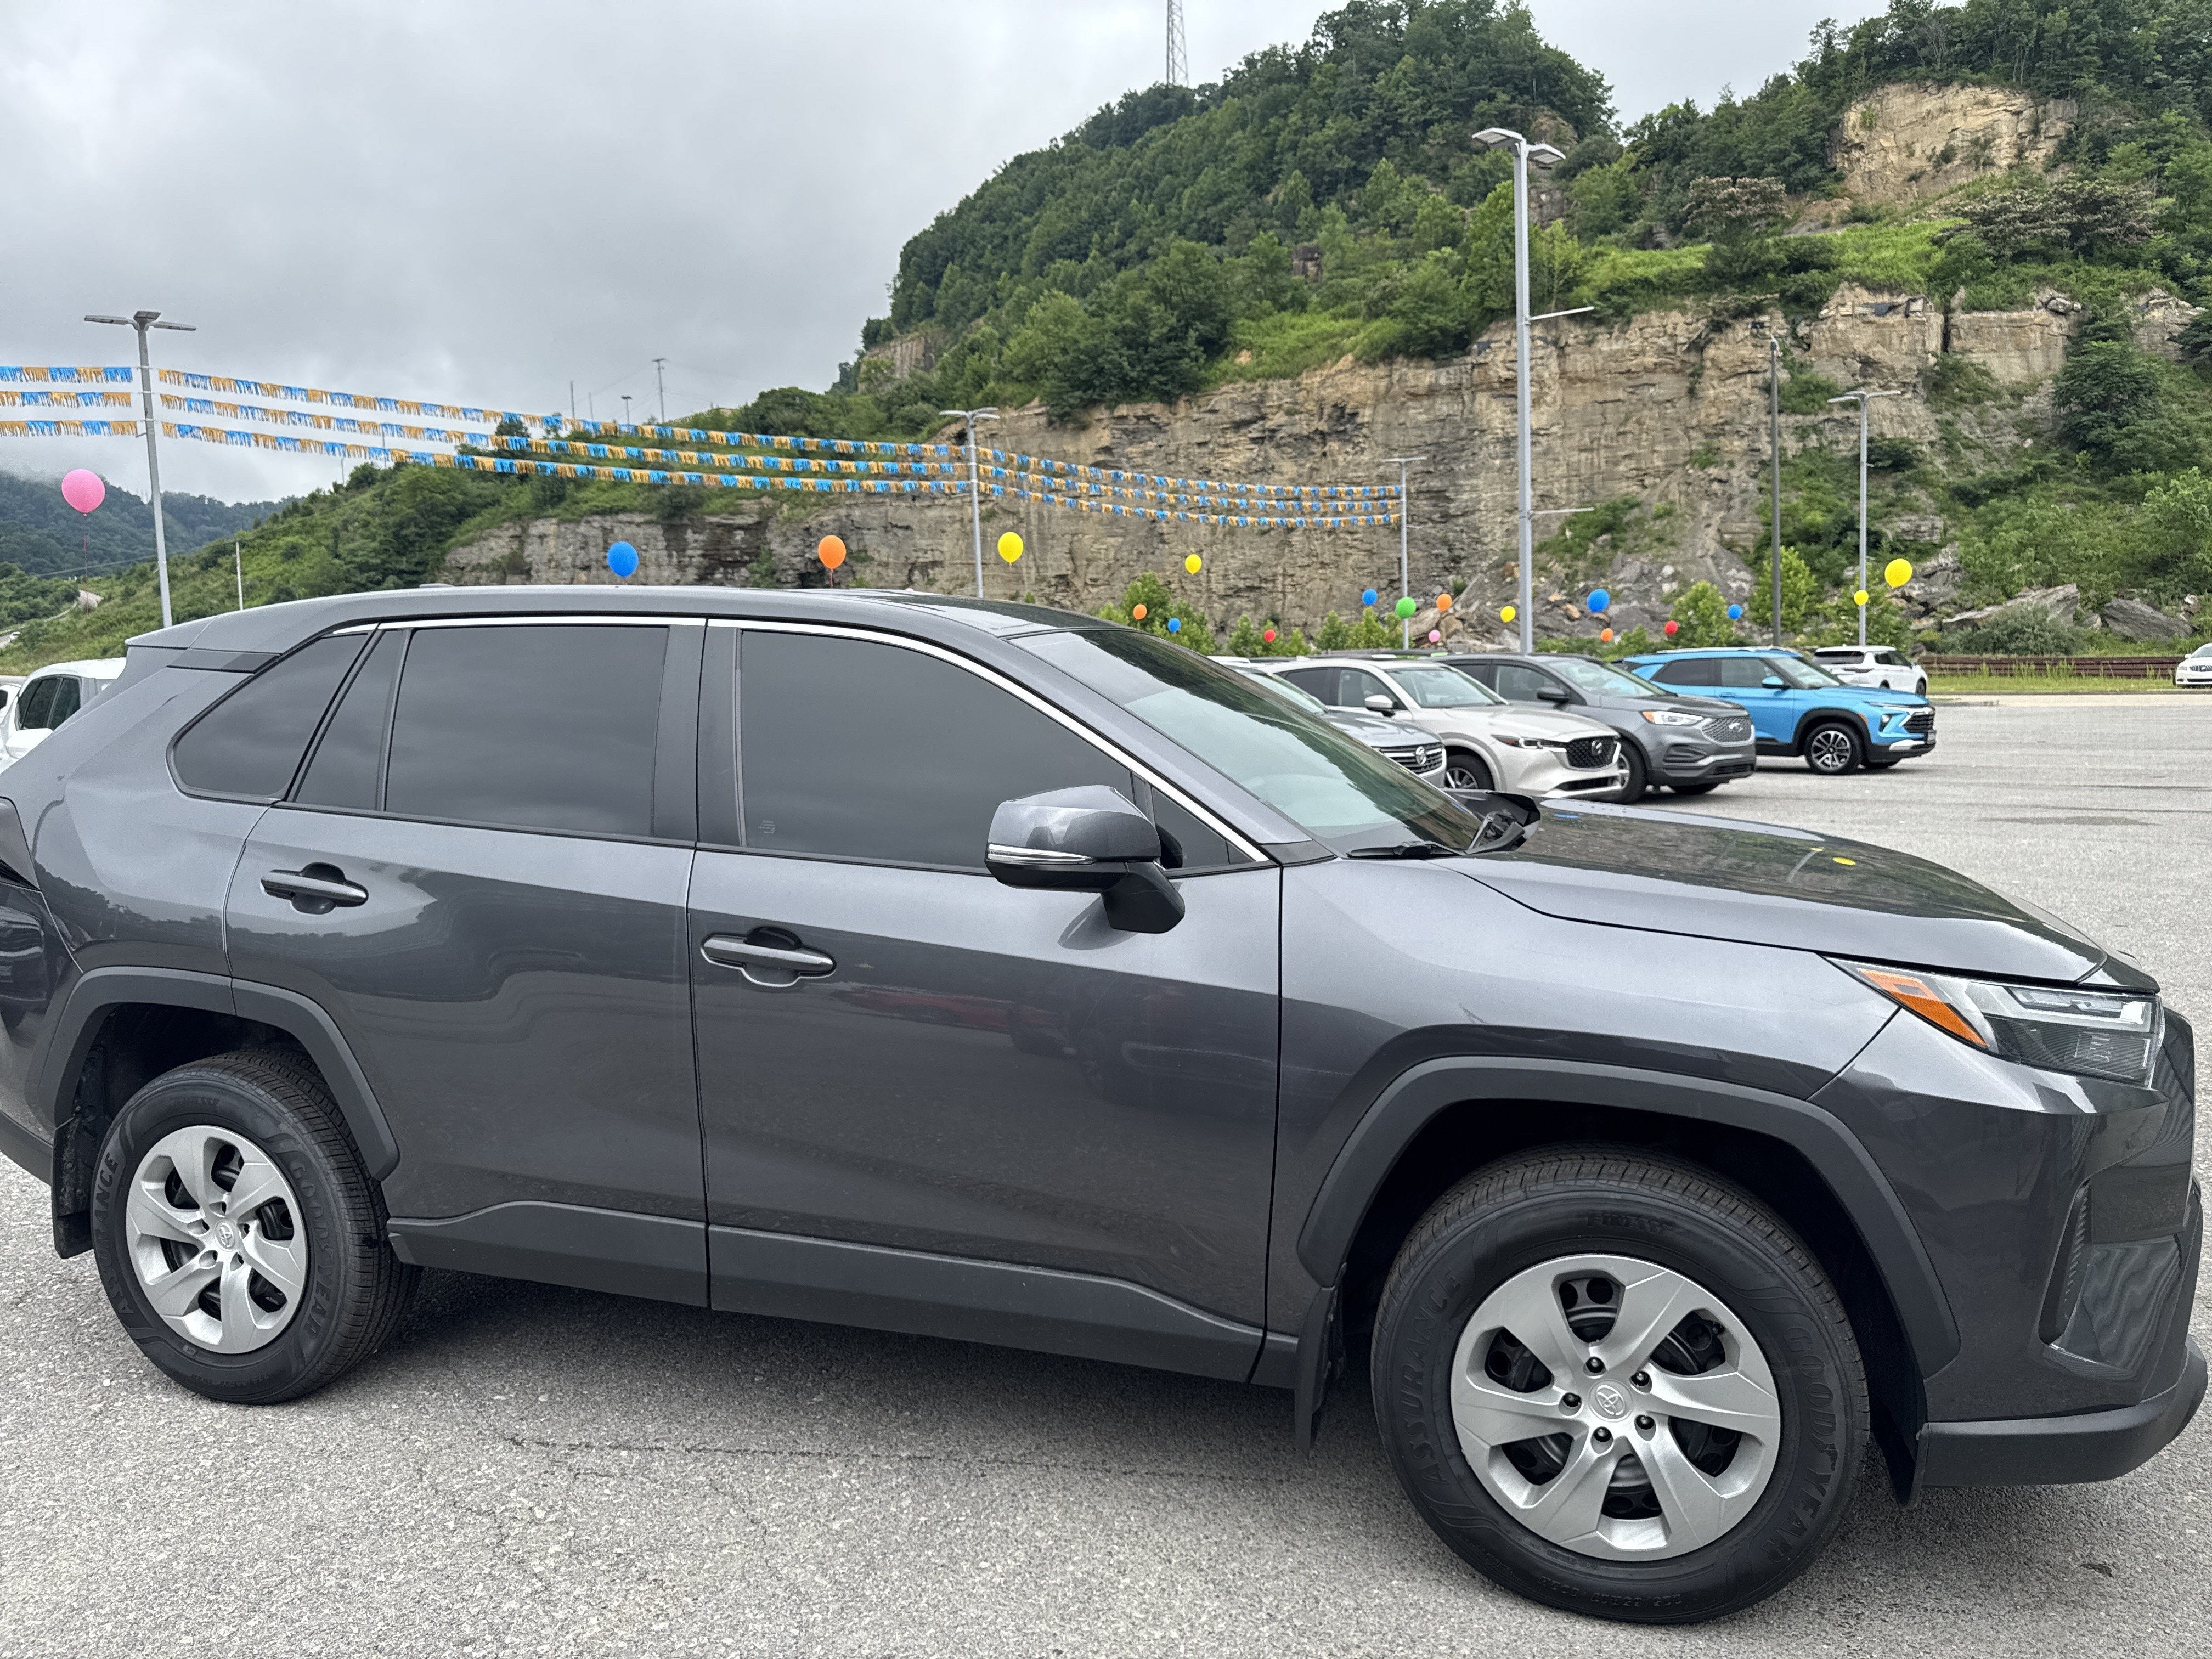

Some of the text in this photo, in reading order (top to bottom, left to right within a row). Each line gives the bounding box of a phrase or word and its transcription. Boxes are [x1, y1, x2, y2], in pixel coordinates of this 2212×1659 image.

[94, 1152, 134, 1314] ASSURANCE
[289, 1160, 334, 1339] GOODYEAR
[1401, 1266, 1463, 1485] ASSURANCE
[1760, 1326, 1837, 1562] GOODYEAR
